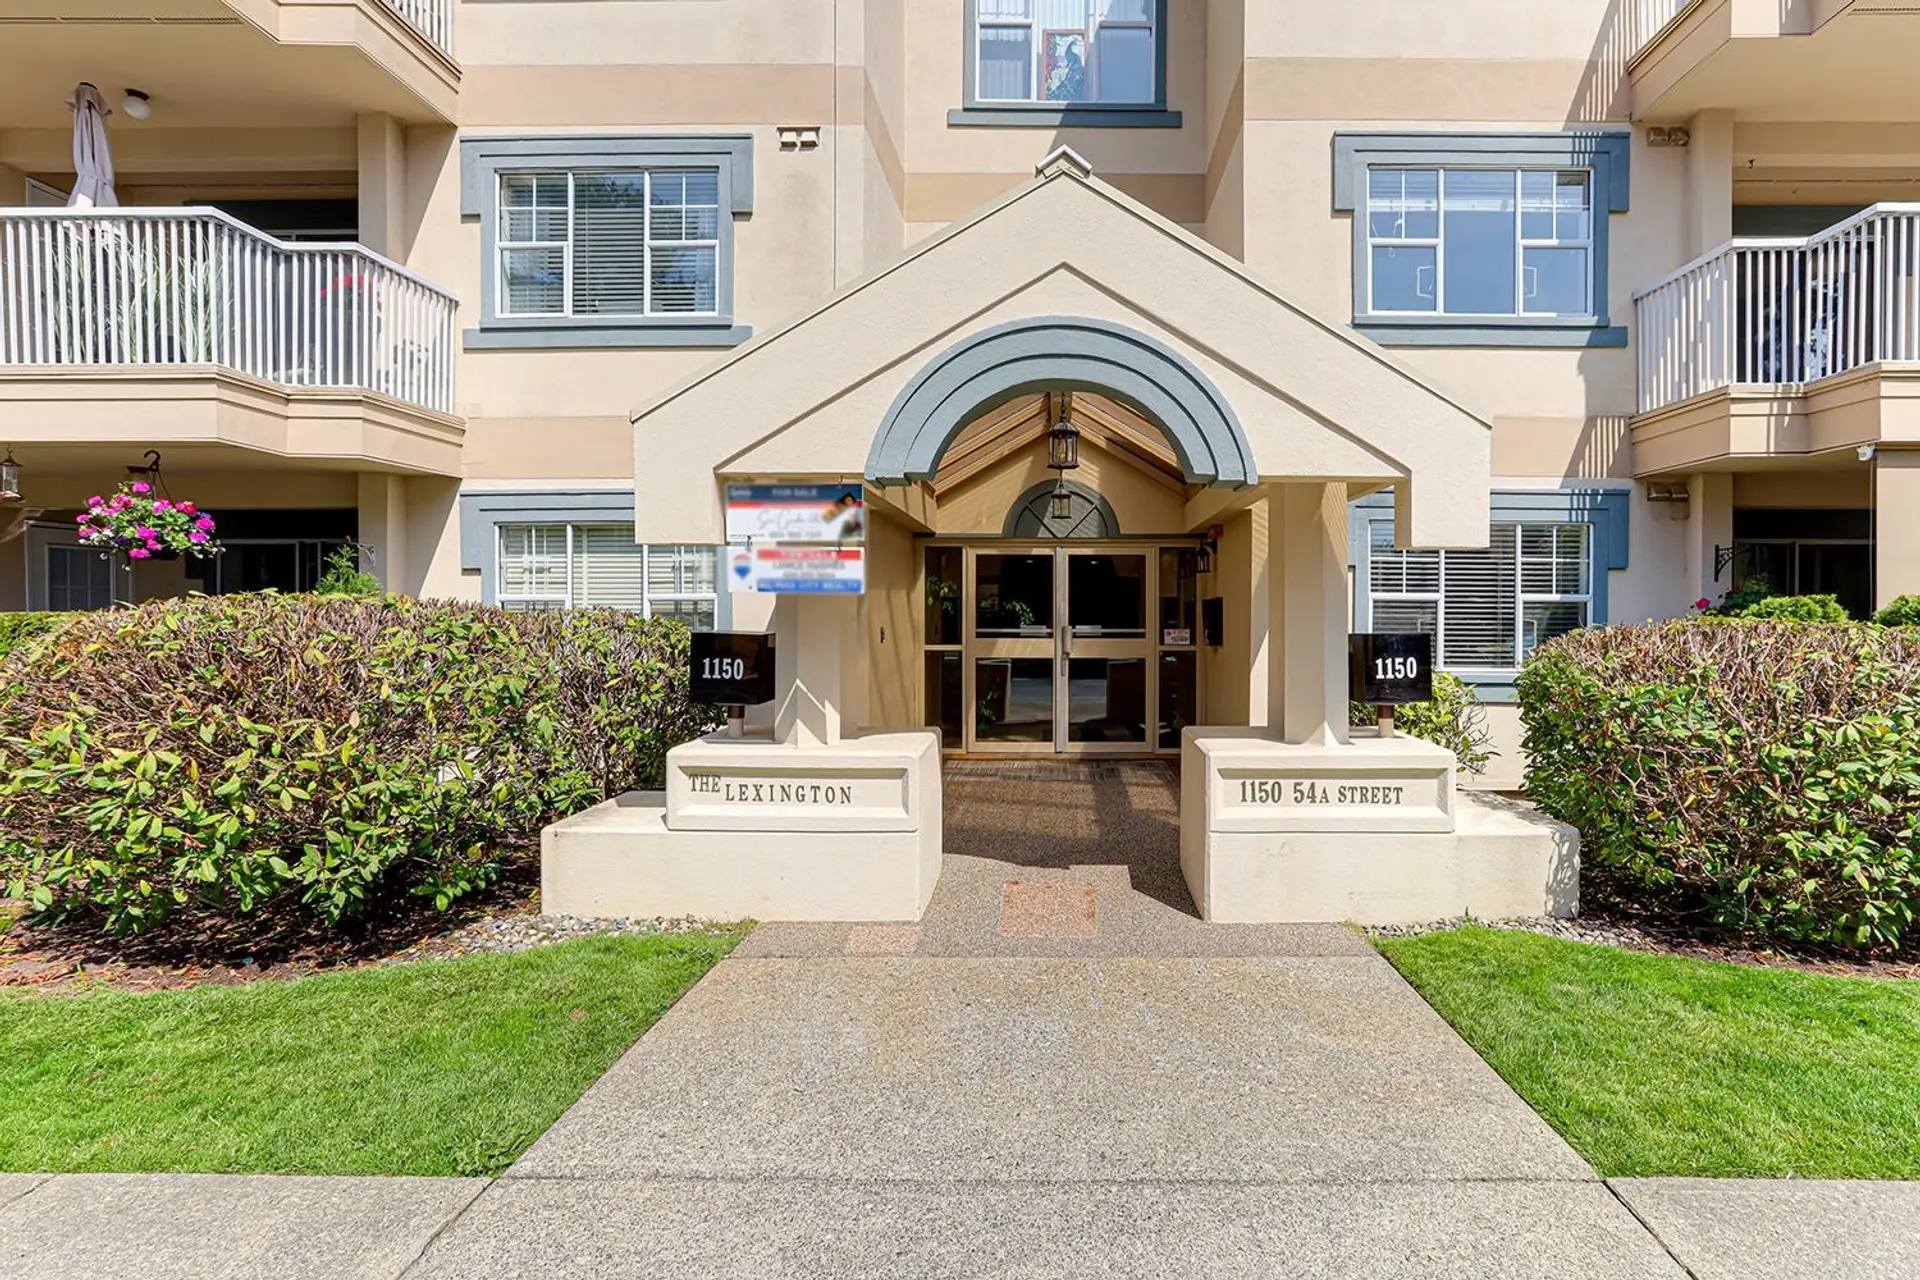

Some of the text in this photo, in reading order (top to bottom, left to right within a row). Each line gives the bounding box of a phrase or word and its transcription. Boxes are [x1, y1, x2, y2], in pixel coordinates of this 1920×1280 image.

[702, 658, 744, 680] 1150
[1375, 656, 1417, 680] 1150
[689, 774, 852, 804] THE LEXINGTON
[1240, 780, 1403, 805] 1150 54A STREET
